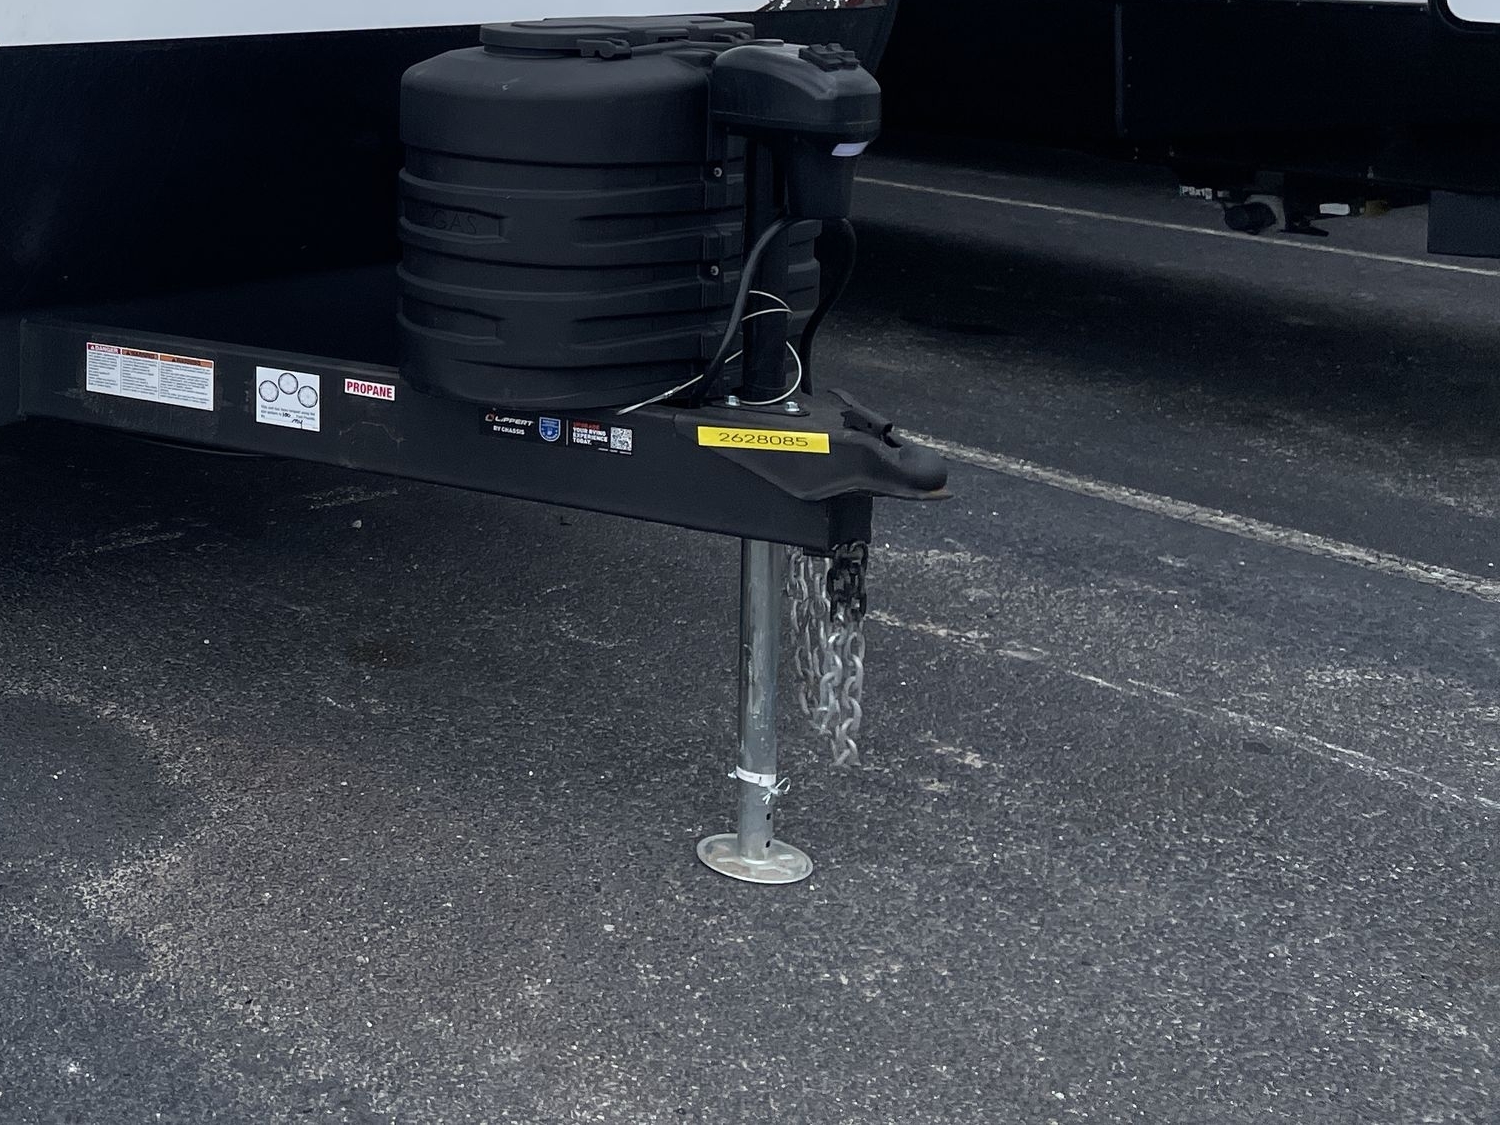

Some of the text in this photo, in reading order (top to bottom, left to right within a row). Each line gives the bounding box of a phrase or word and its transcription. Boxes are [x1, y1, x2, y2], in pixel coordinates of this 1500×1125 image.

[346, 381, 393, 399] PROPANE
[494, 415, 535, 427] LIPPERT
[501, 426, 525, 435] CHASSIS
[718, 432, 809, 447] 2628085
